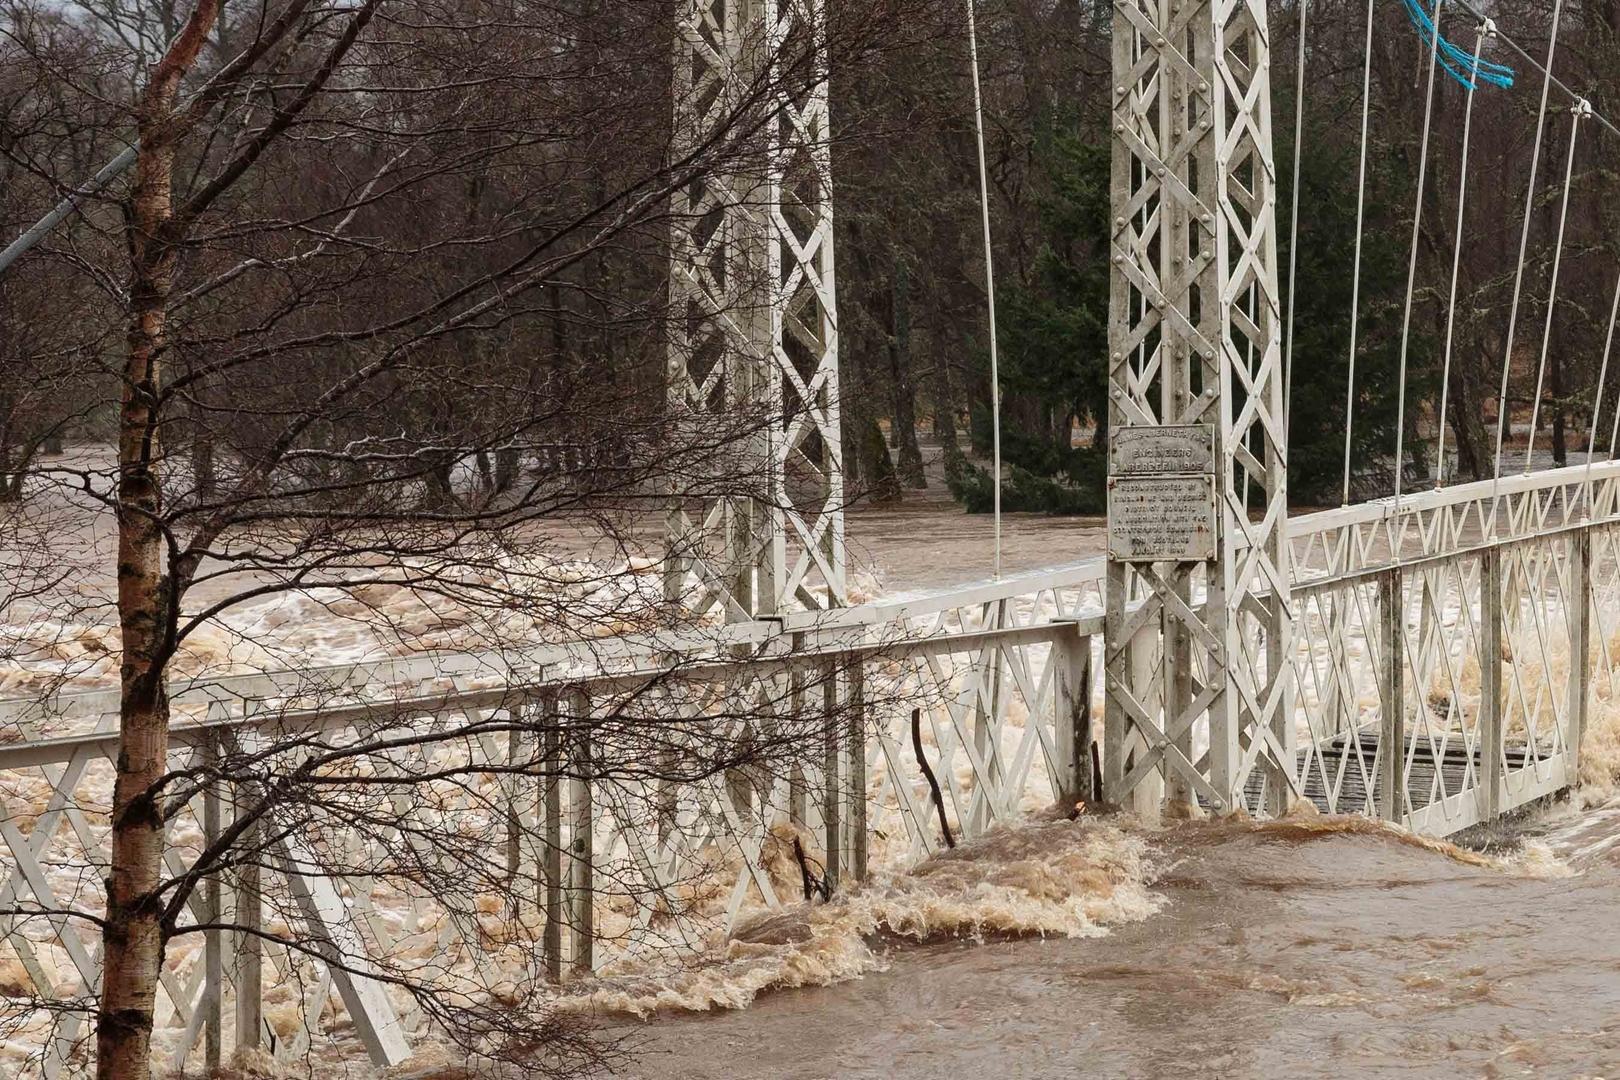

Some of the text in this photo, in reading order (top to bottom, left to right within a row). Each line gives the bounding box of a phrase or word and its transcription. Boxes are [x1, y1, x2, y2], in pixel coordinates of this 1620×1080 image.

[1133, 447, 1192, 458] ENGINEERS
[1120, 461, 1204, 472] ABERDEEN 1905
